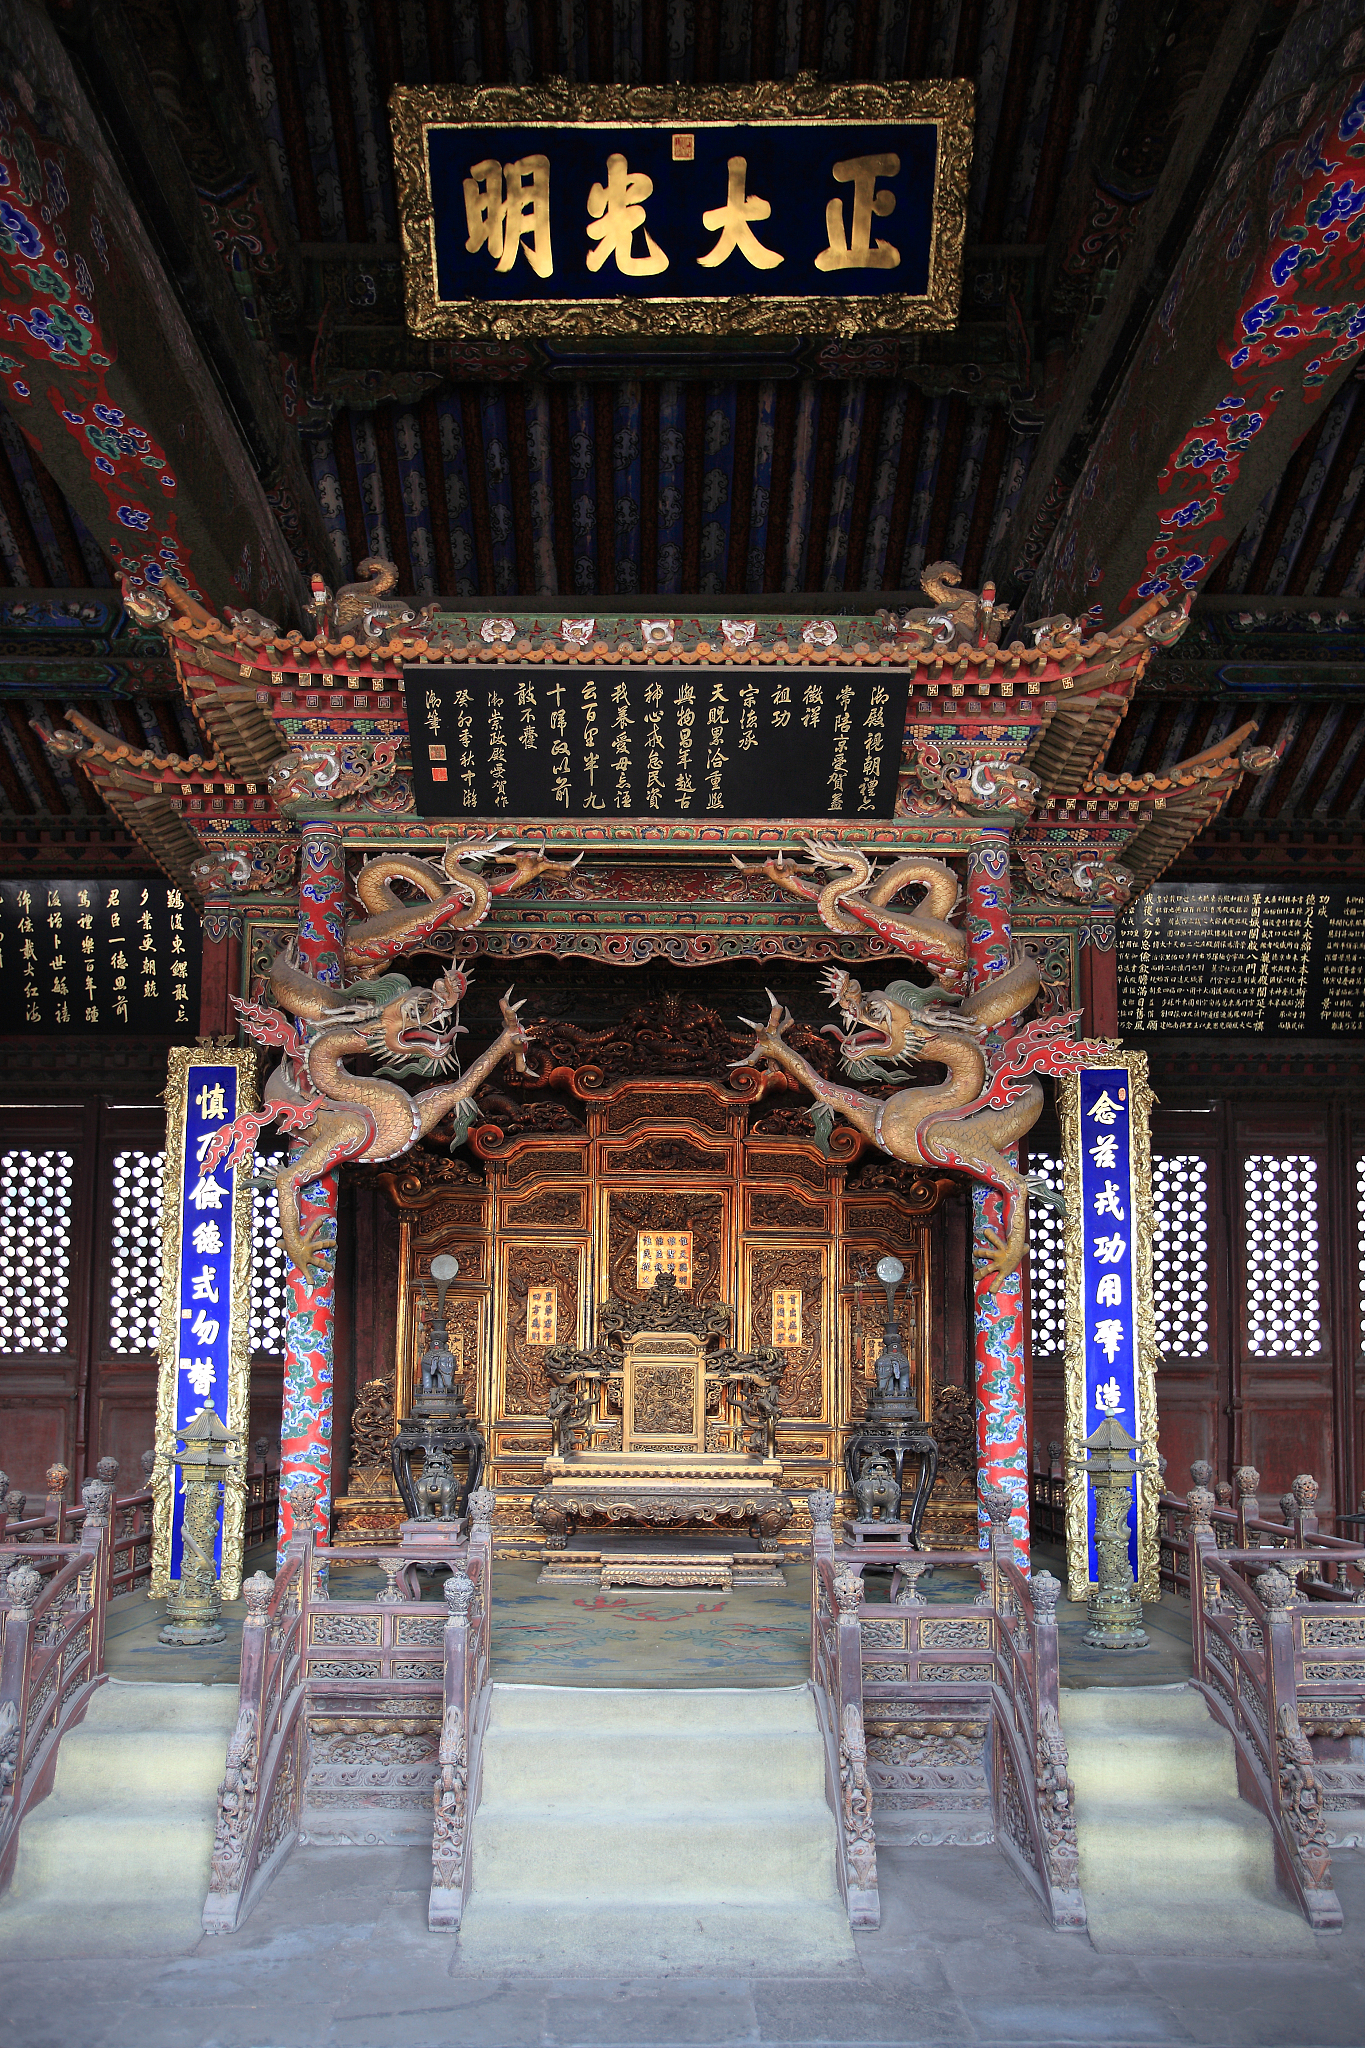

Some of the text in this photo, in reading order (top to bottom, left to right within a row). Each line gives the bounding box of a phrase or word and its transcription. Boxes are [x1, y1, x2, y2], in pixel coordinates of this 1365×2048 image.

[462, 151, 901, 278] 正大光明
[580, 680, 606, 810] 云百里半九
[673, 682, 697, 810] 與物昌年越古
[770, 684, 792, 728] 祖功
[106, 888, 129, 1024] 君臣一德思前
